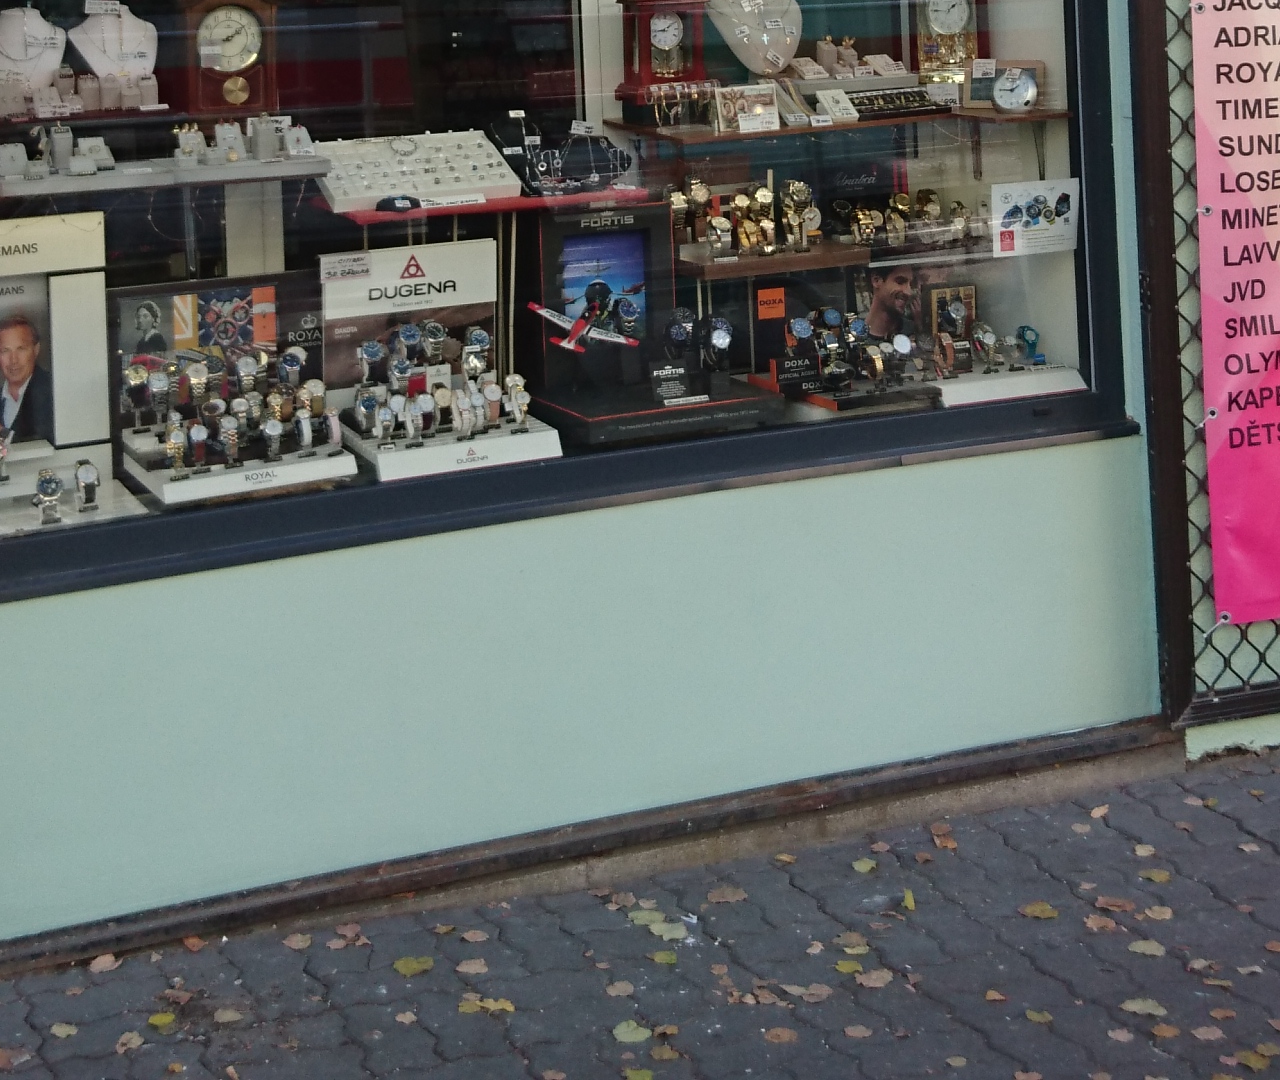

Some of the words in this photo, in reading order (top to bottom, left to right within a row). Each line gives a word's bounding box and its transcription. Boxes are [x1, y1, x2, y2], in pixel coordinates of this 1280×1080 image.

[580, 214, 635, 228] FORTIS
[368, 279, 457, 301] DUGENA
[1223, 278, 1266, 304] JVD
[759, 298, 784, 307] DOXA
[288, 330, 322, 342] ROYA
[784, 358, 810, 368] DOXA
[653, 367, 685, 377] FORTIS
[244, 470, 278, 482] ROYAL
